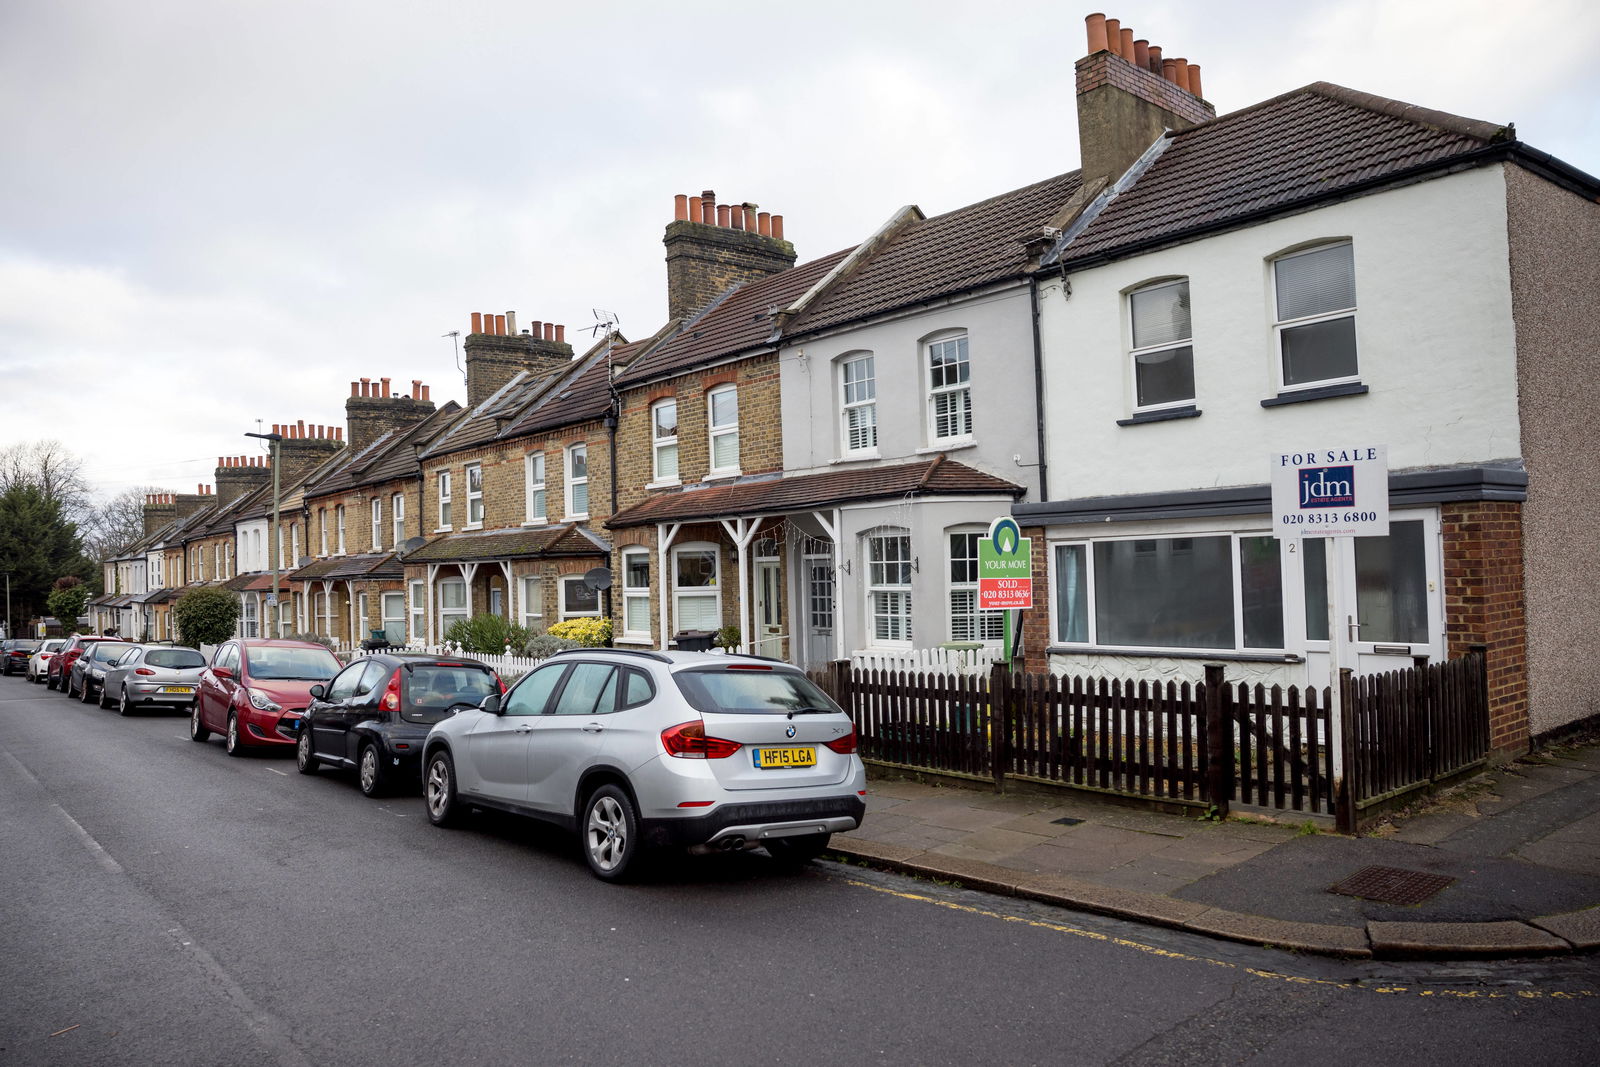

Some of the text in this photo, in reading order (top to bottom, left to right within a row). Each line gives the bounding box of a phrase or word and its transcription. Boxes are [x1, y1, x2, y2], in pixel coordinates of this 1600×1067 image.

[1281, 448, 1376, 466] FOR SALE
[1302, 472, 1352, 504] jdm
[1283, 512, 1376, 524] 020 8313 6800
[1289, 544, 1296, 552] 2
[985, 560, 1026, 569] YOUR MOVE
[998, 580, 1018, 588] SOLD
[764, 750, 812, 763] HF15 LGA
